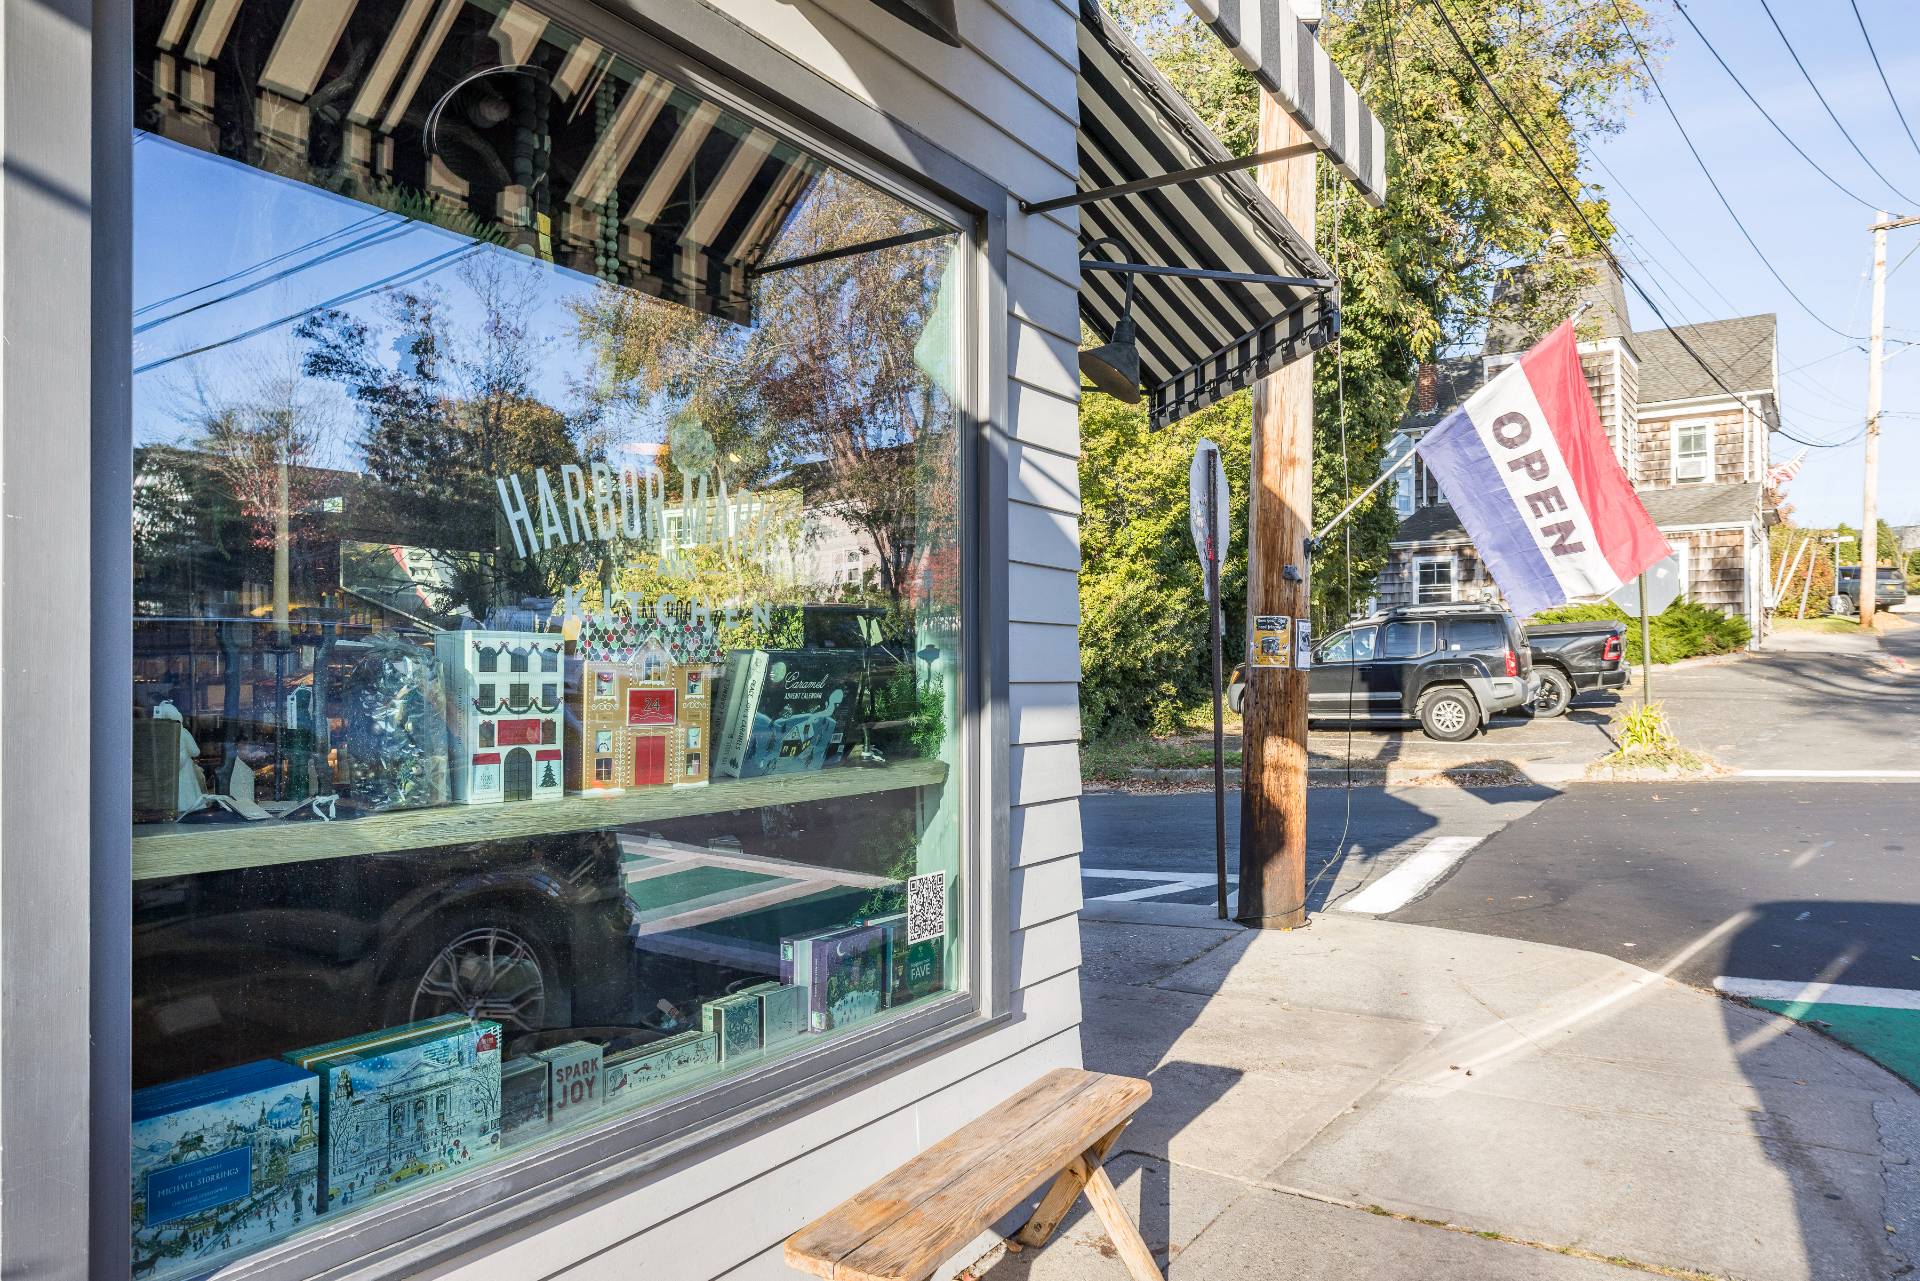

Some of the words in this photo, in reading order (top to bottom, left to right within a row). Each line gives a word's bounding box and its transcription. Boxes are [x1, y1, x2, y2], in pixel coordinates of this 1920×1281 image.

[1492, 412, 1586, 557] OPEN
[496, 462, 665, 559] HARBOR
[785, 671, 829, 690] Caramel
[643, 697, 660, 712] 24
[784, 692, 801, 700] ADVENT
[801, 692, 823, 700] CALENDAR
[911, 963, 931, 981] FAVE
[556, 1057, 599, 1083] SPARK
[556, 1076, 596, 1109] JOY
[196, 1167, 240, 1187] STORRINGS
